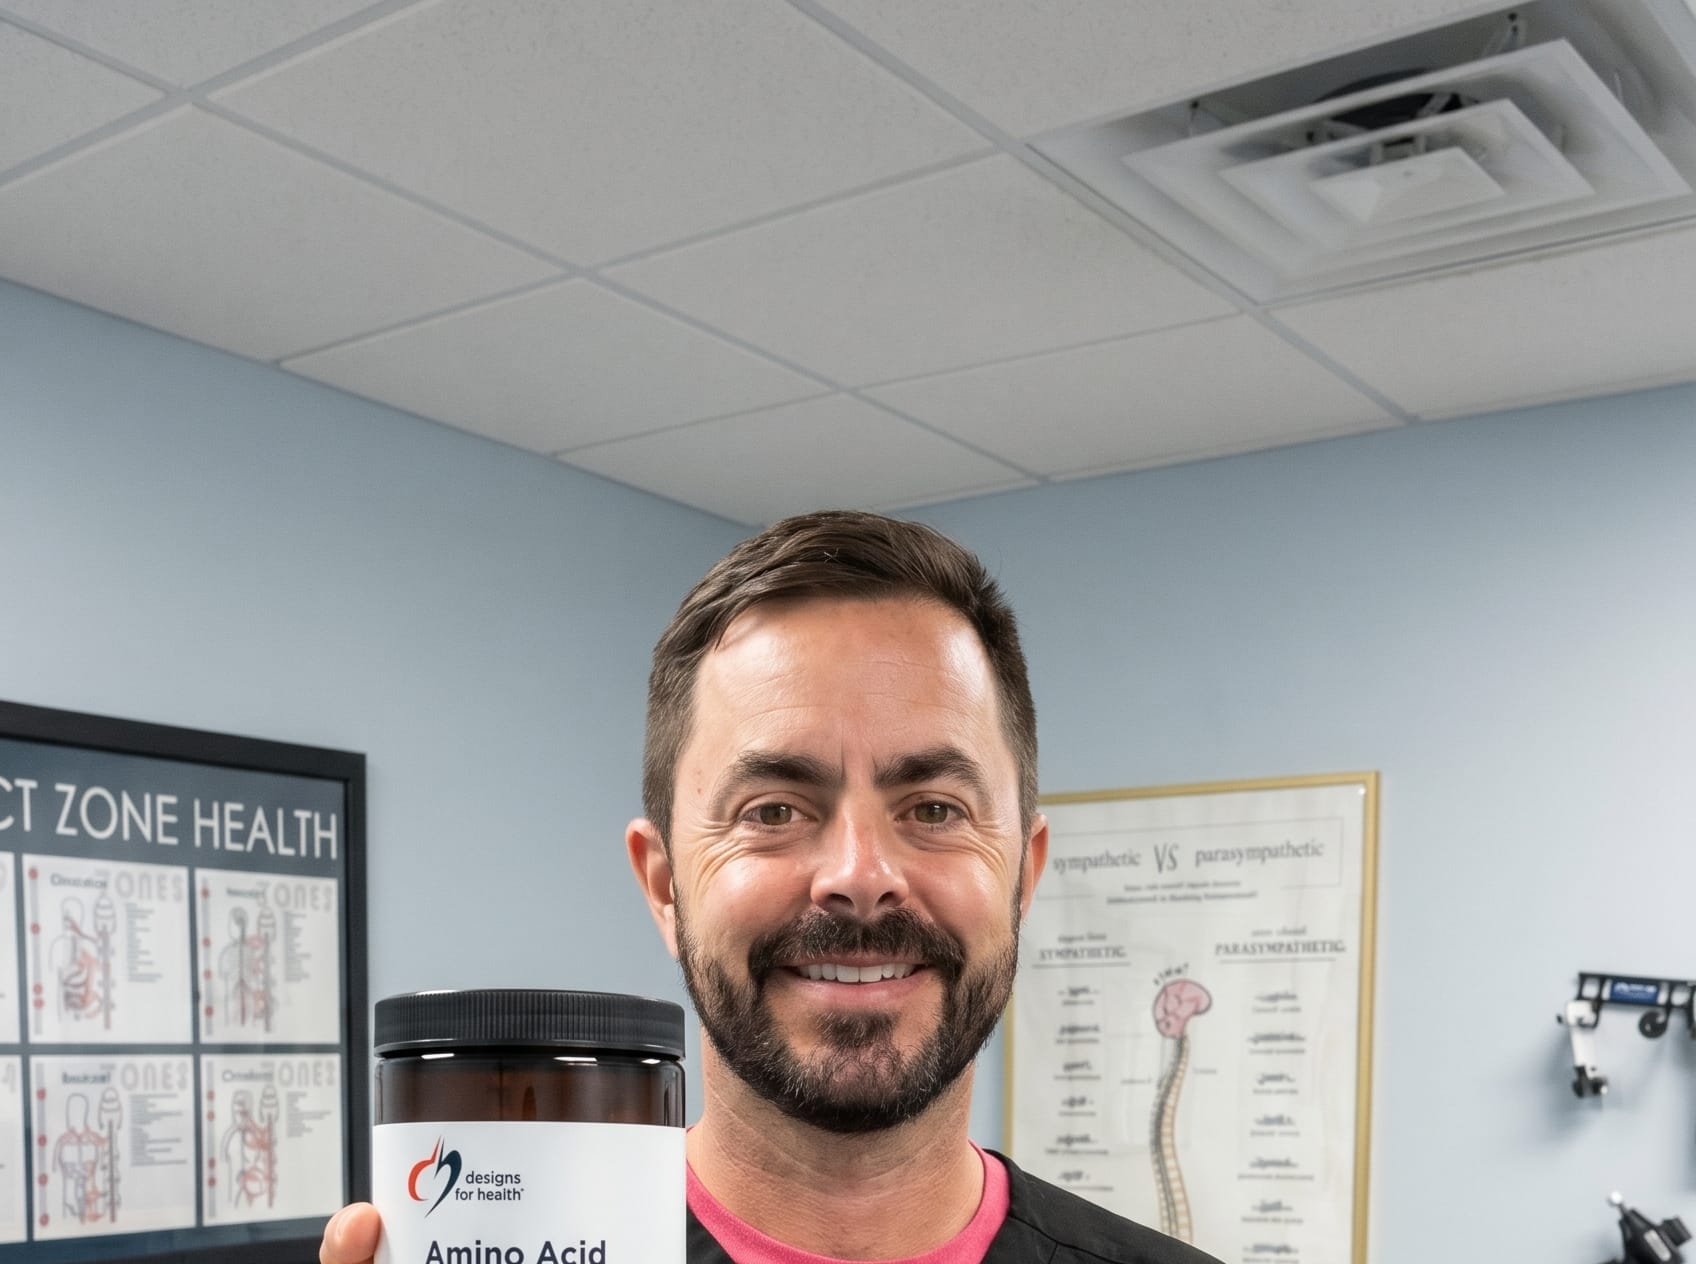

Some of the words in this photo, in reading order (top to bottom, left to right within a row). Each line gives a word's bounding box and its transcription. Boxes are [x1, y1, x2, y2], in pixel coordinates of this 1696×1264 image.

[54, 782, 179, 846] ZONE
[193, 798, 338, 860] HEALTH
[1153, 843, 1179, 874] VS
[465, 1171, 521, 1187] designs
[455, 1188, 474, 1200] for
